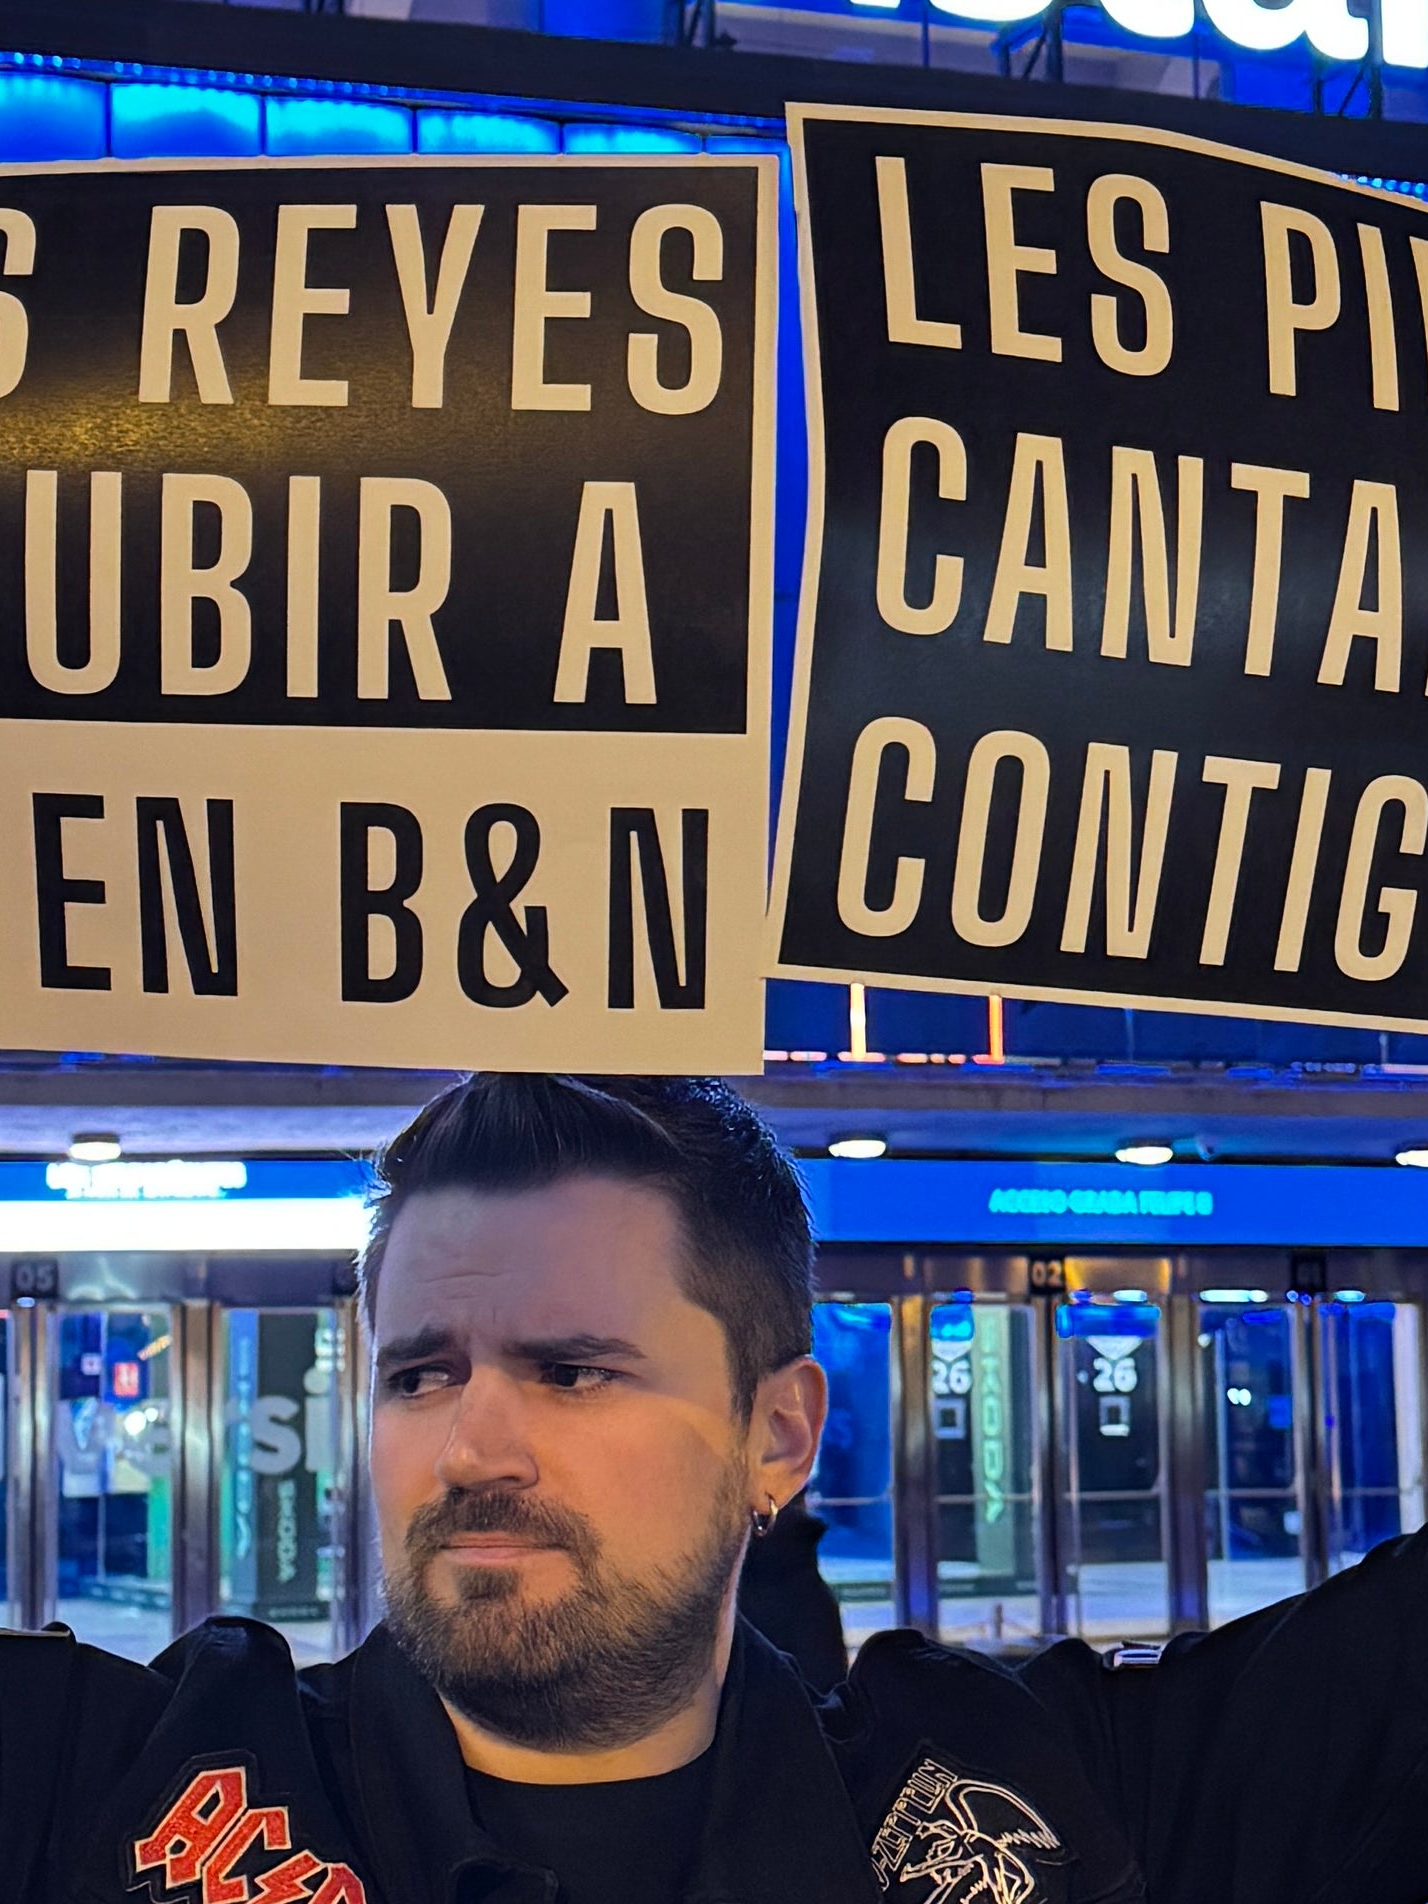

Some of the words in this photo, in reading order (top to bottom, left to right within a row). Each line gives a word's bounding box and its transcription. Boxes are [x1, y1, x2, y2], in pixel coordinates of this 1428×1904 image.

[138, 204, 725, 415] REYES
[875, 154, 1173, 377] LES
[554, 481, 659, 705] A
[32, 792, 239, 999] EN
[339, 801, 709, 1013] B&N
[16, 1265, 54, 1290] 05
[1031, 1261, 1062, 1287] 02
[931, 1358, 972, 1394] 26
[1093, 1357, 1138, 1393] 26
